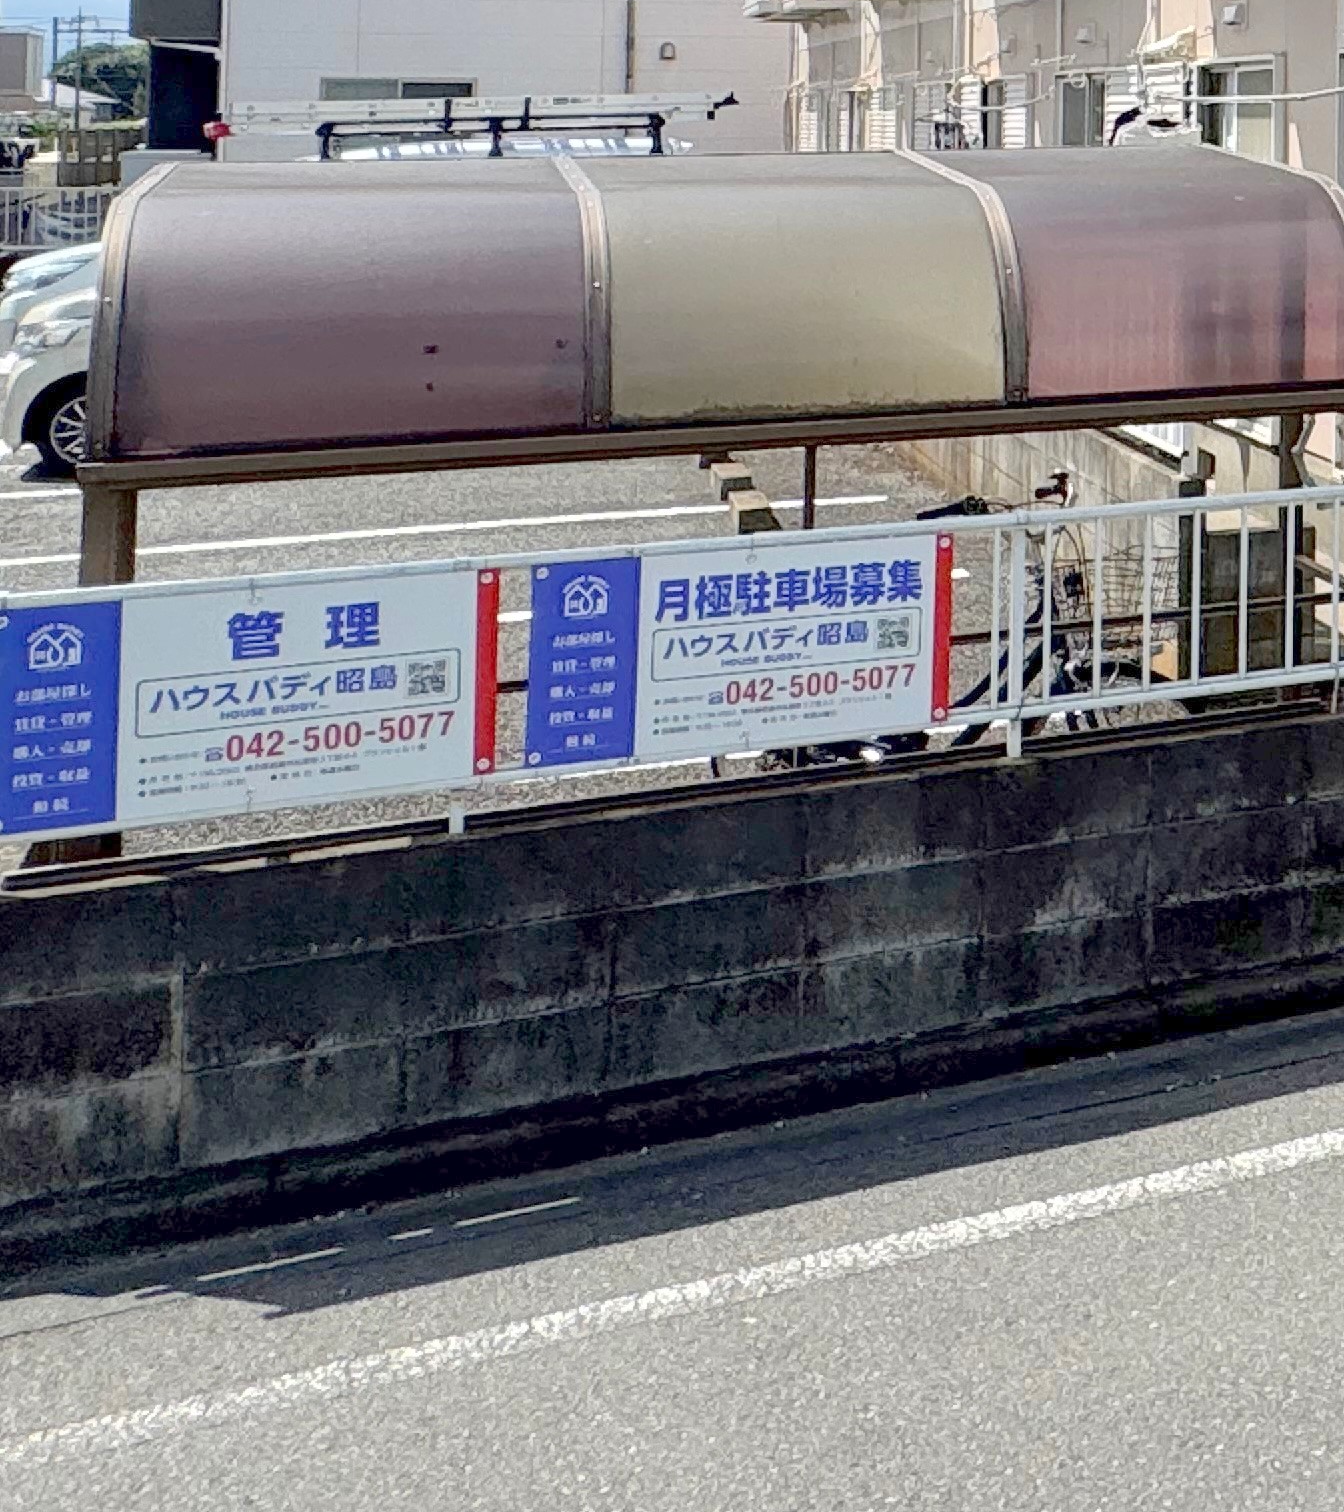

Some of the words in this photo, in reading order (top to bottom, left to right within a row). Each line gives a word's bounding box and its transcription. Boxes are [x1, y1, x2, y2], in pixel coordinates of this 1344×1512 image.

[655, 559, 923, 623] 月極駐車場募集
[227, 601, 380, 661] 管理
[726, 662, 917, 706] 042-500-5077
[225, 710, 456, 763] 042-500-5077
